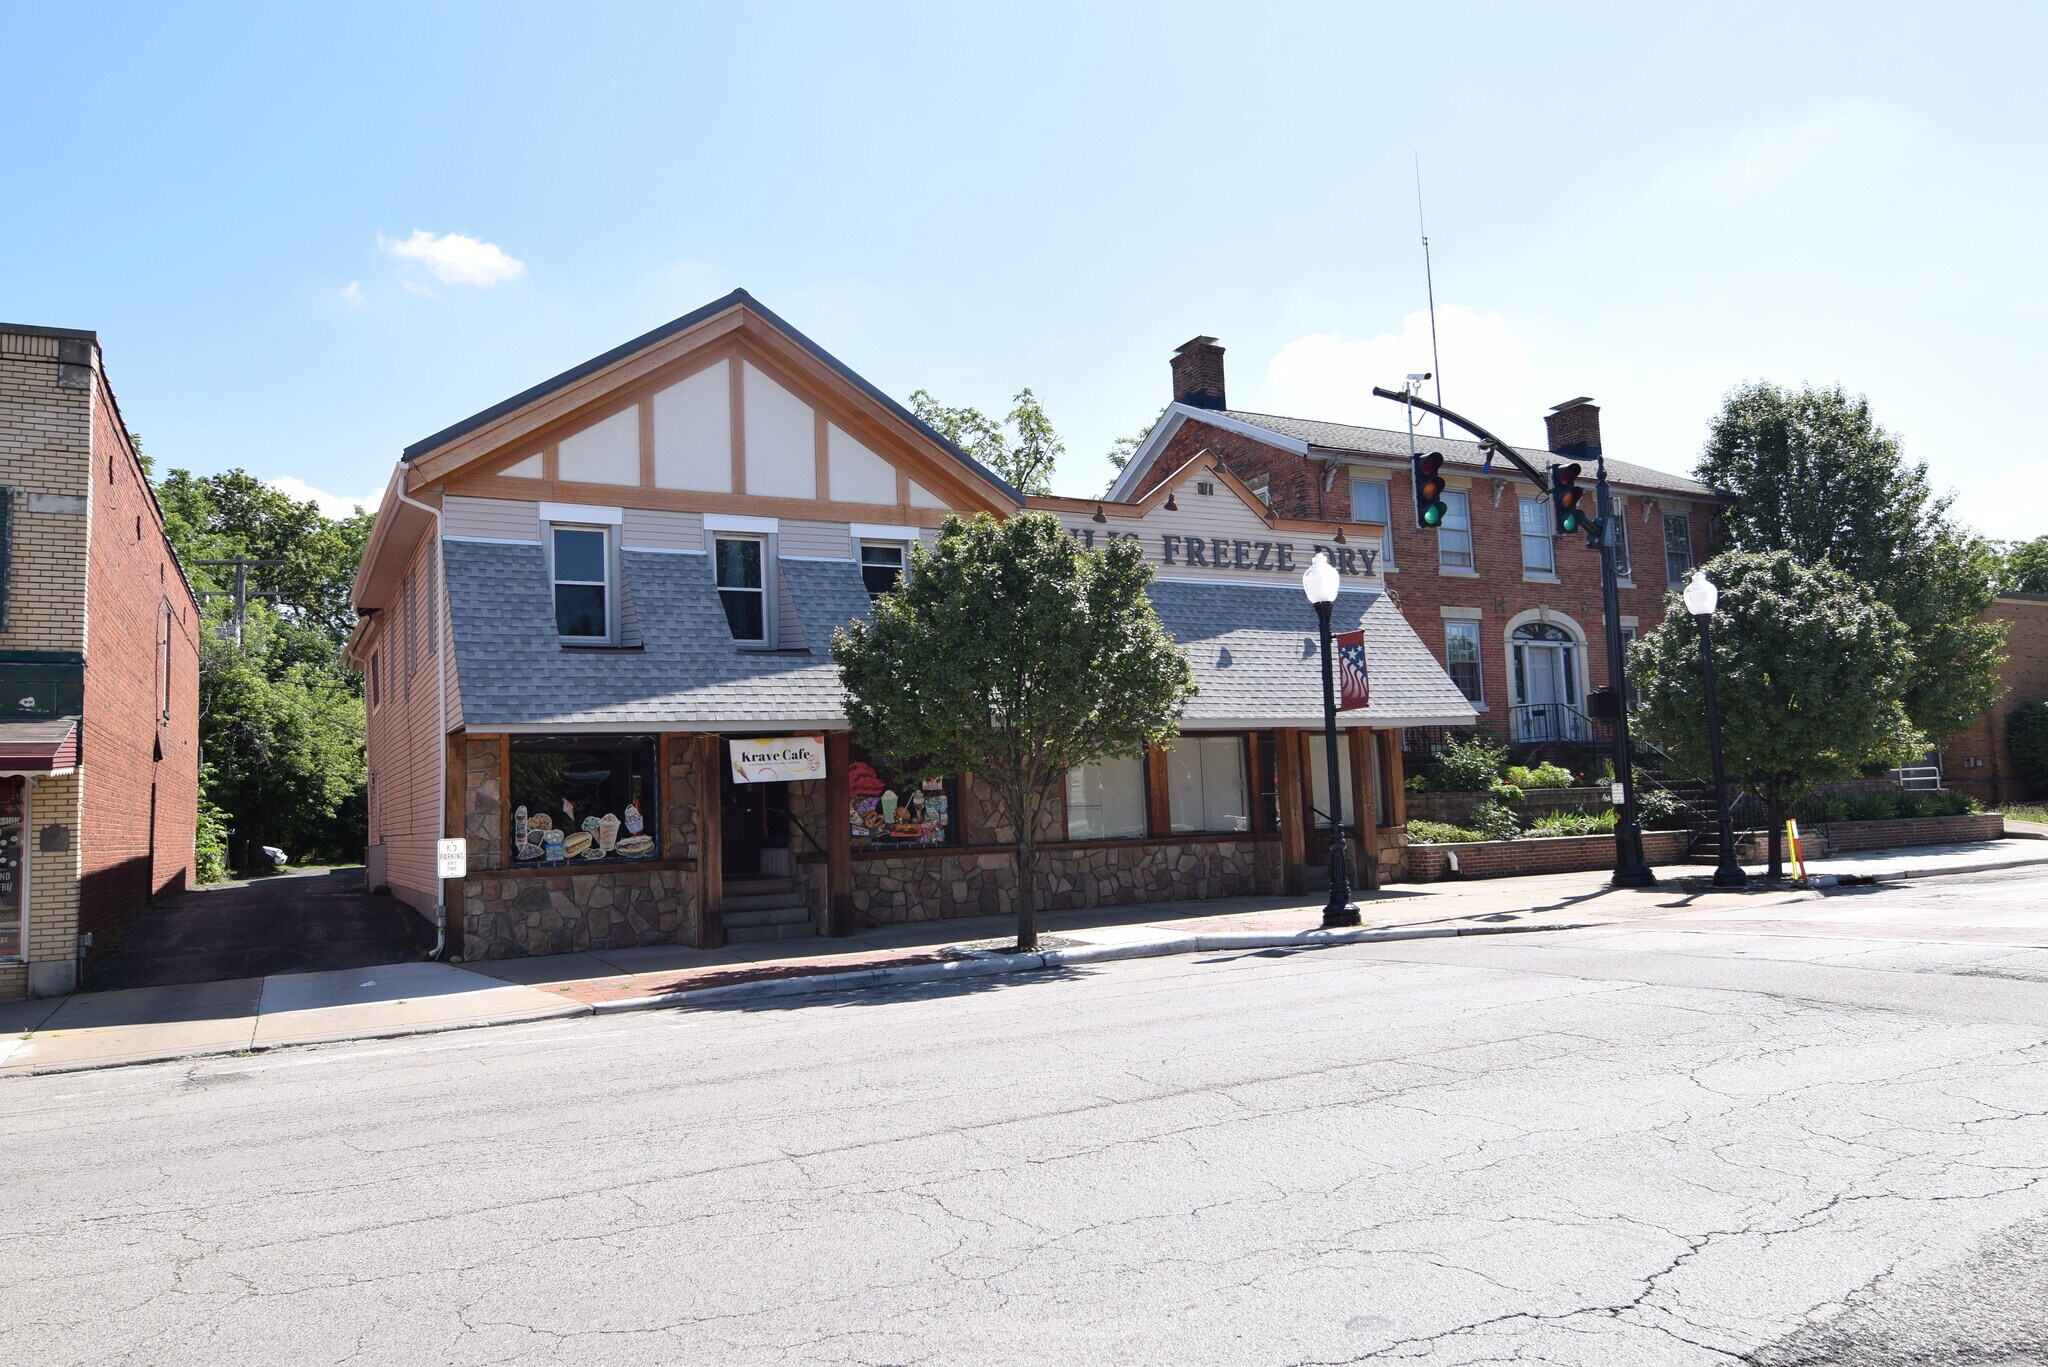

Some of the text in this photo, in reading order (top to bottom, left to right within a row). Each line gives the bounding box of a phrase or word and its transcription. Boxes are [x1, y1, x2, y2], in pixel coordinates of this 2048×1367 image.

[1162, 535, 1296, 572] FREEZE
[742, 748, 810, 763] Krave Cafe
[446, 844, 458, 852] NO
[440, 852, 464, 861] PARKING
